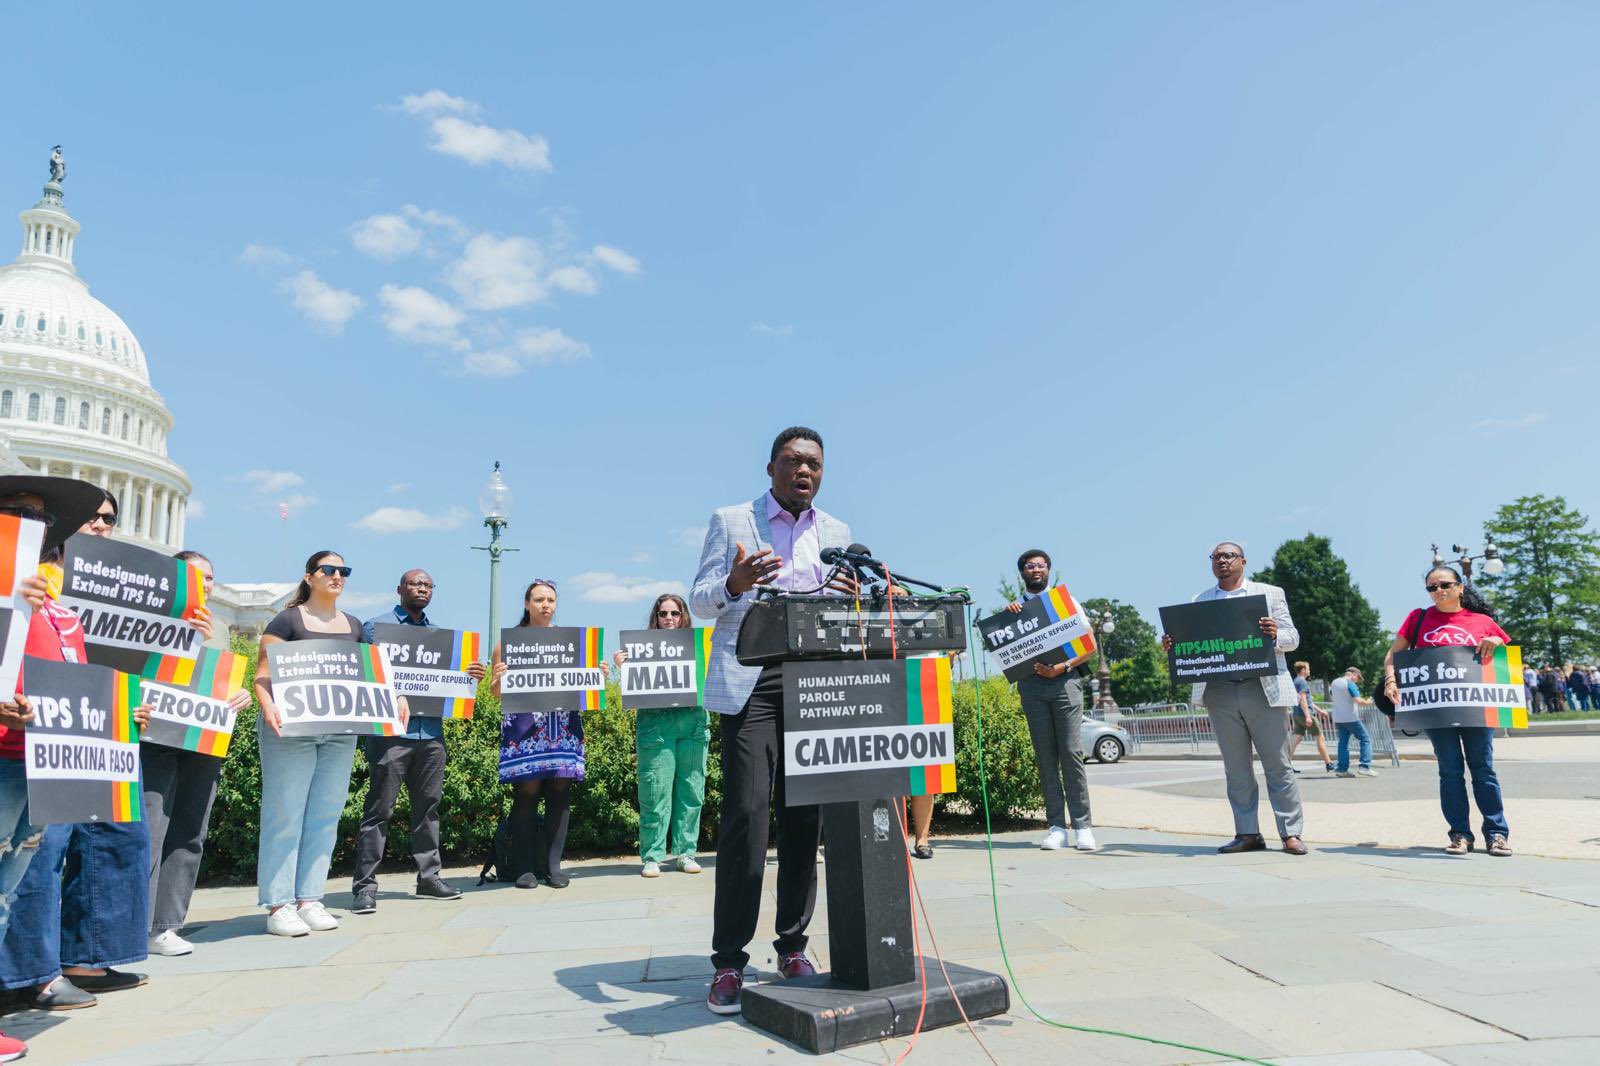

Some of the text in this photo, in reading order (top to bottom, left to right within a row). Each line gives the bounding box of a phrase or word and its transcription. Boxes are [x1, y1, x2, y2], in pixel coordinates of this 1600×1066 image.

[73, 557, 170, 592] Redesignate &
[71, 575, 165, 608] Extend TPS for
[987, 617, 1039, 647] TPS for
[998, 618, 1078, 659] THE DEMOCRATIC REPUBLIC
[1423, 624, 1477, 646] CASA
[416, 645, 441, 664] for
[506, 643, 575, 655] Redesignate &
[625, 641, 684, 659] TPS for
[1003, 643, 1044, 665] OF THE CONGO
[1175, 635, 1263, 656] #TPS4Nigeria
[276, 653, 358, 664] Redesignate &
[506, 654, 574, 666] Extend TPS for
[1176, 655, 1225, 666] #Protection4All
[278, 664, 359, 677] Extend TPS for
[394, 671, 473, 685] DEMOCRATIC REPUBLIC
[506, 672, 600, 688] SOUTH SUDAN
[627, 665, 690, 690] MALI
[1399, 662, 1467, 684] TPS for
[404, 682, 430, 691] CONGO
[798, 674, 890, 688] HUMANITARIAN
[141, 686, 229, 727] EROON
[284, 684, 395, 718] SUDAN
[799, 691, 845, 703] PAROLE
[1400, 687, 1519, 707] MAURITANIA
[27, 695, 106, 732] TPS for
[800, 704, 883, 719] PATHWAY FOR
[34, 743, 135, 774] BURKINA FASO
[794, 731, 947, 767] CAMEROON
